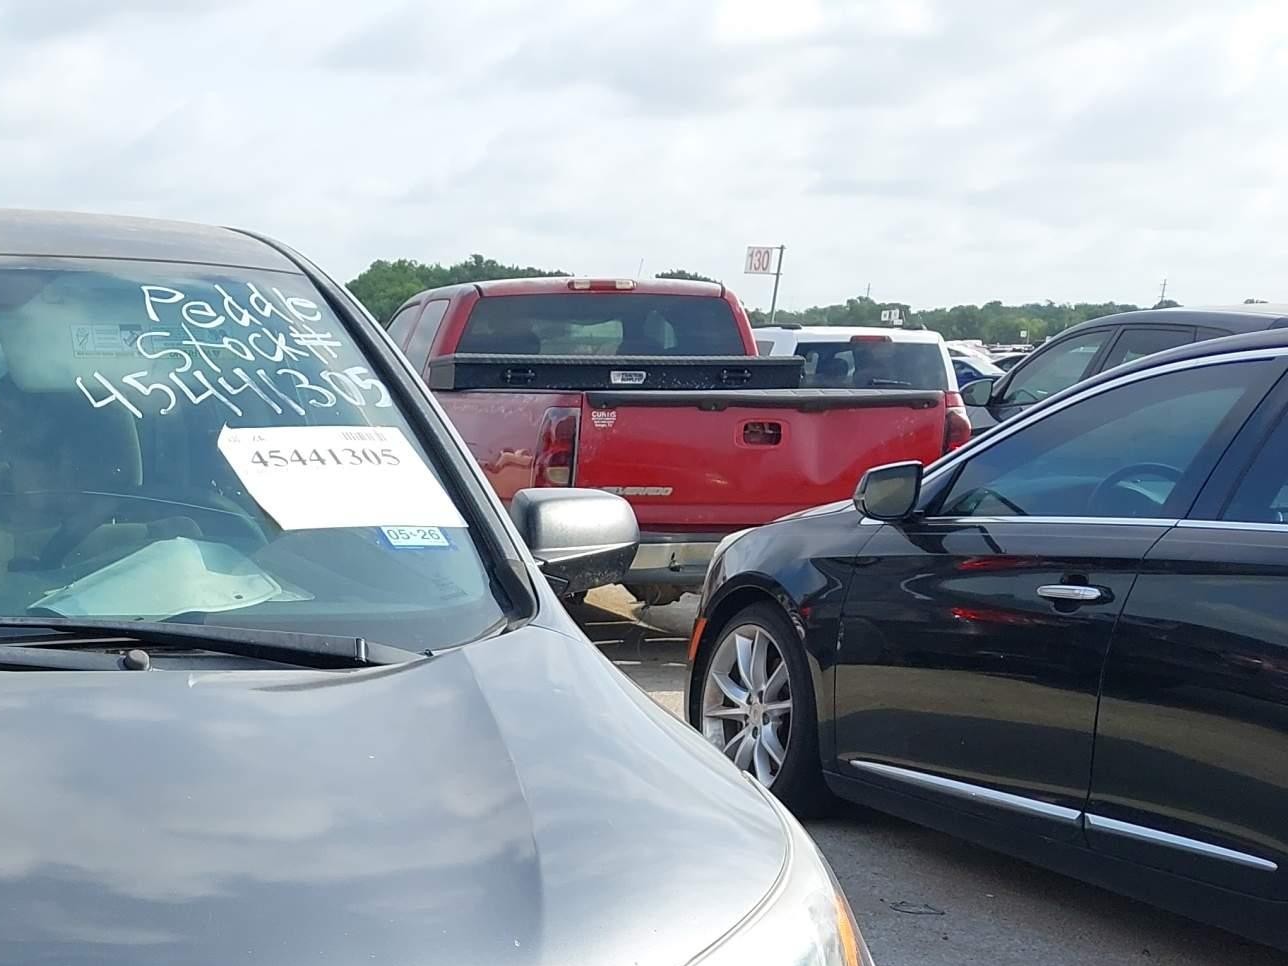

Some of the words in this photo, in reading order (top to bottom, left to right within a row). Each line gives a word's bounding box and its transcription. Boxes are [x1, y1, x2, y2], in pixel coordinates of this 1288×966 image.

[749, 249, 769, 271] 130
[75, 366, 393, 418] 45441305
[251, 448, 400, 467] 45441305
